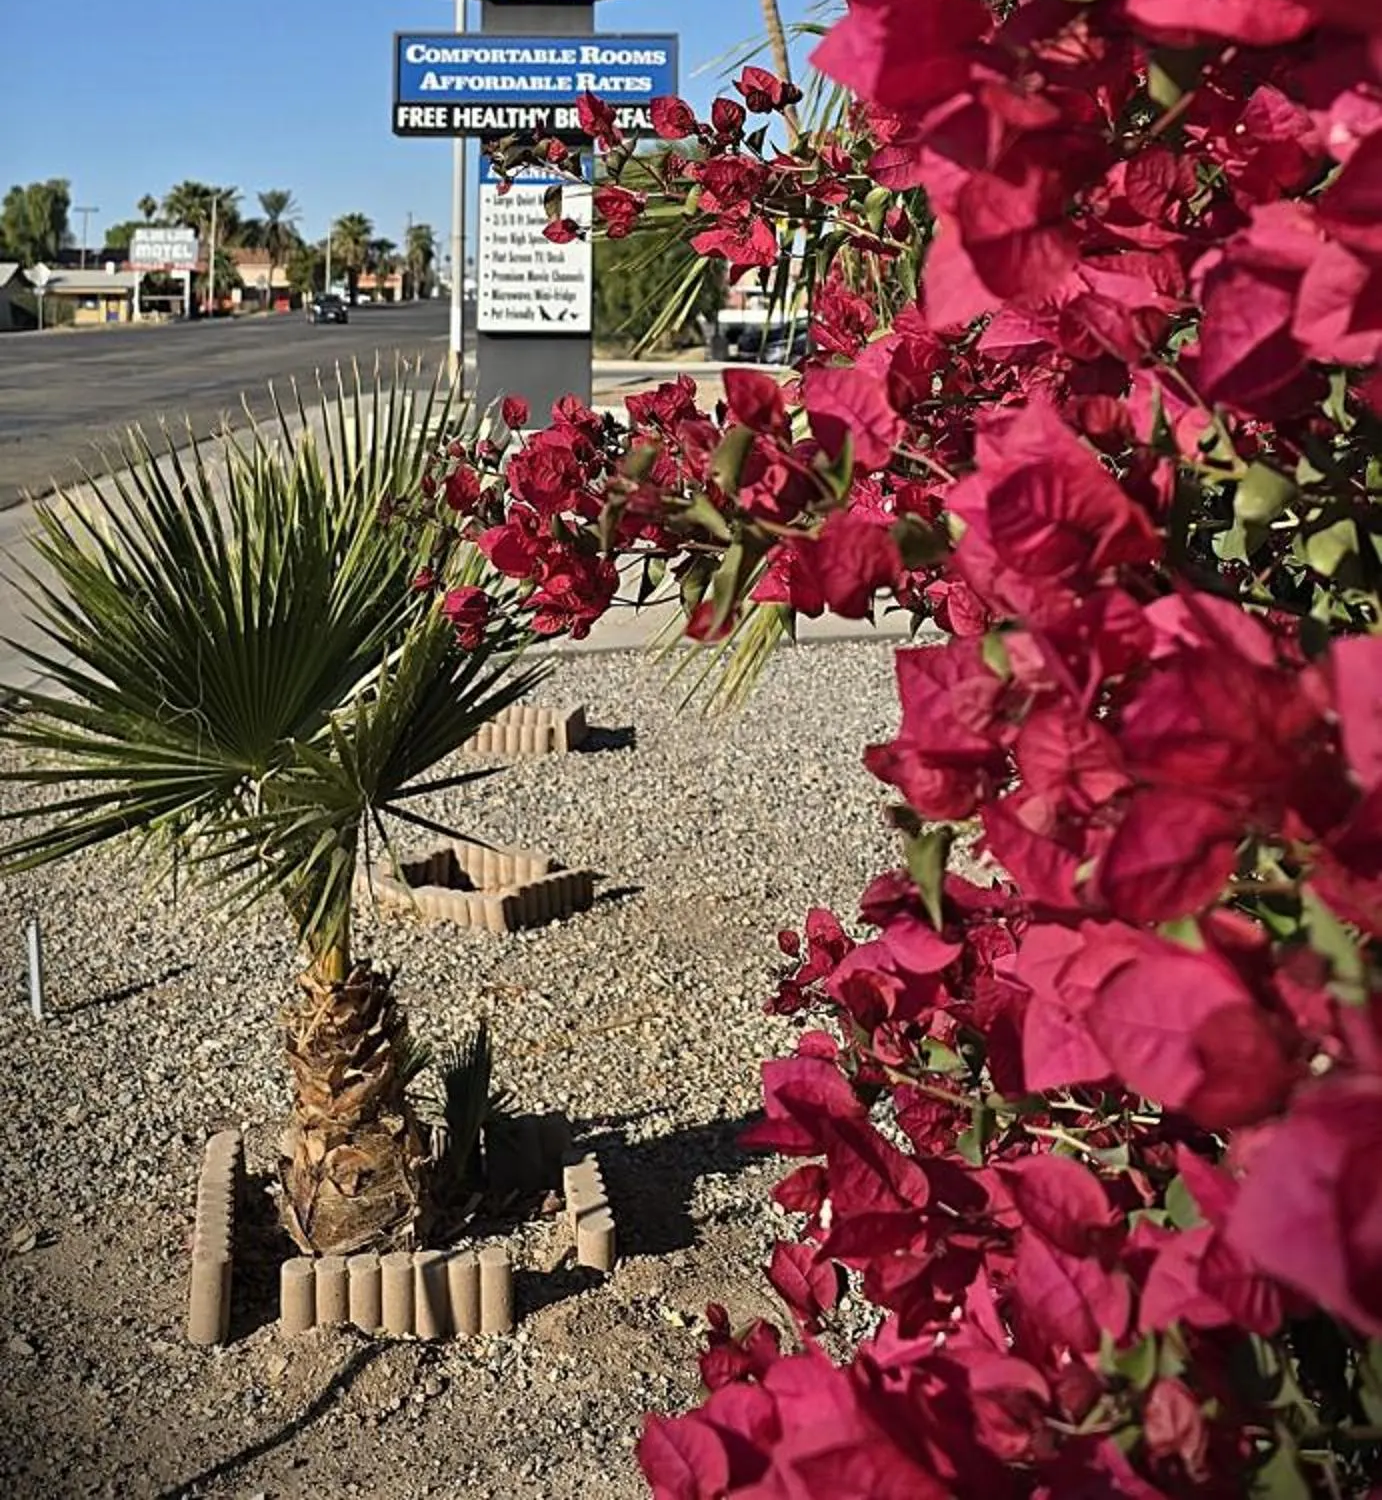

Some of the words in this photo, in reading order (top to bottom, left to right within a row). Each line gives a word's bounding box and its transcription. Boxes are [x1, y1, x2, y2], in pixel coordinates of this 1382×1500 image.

[406, 44, 577, 65] COMFORTABLE
[579, 46, 666, 66] ROOMS
[420, 71, 572, 92] AFFORDABLE
[575, 71, 652, 92] RATES
[397, 106, 447, 128] FREE
[454, 106, 550, 129] HEALTHY
[135, 243, 193, 259] MOTEL
